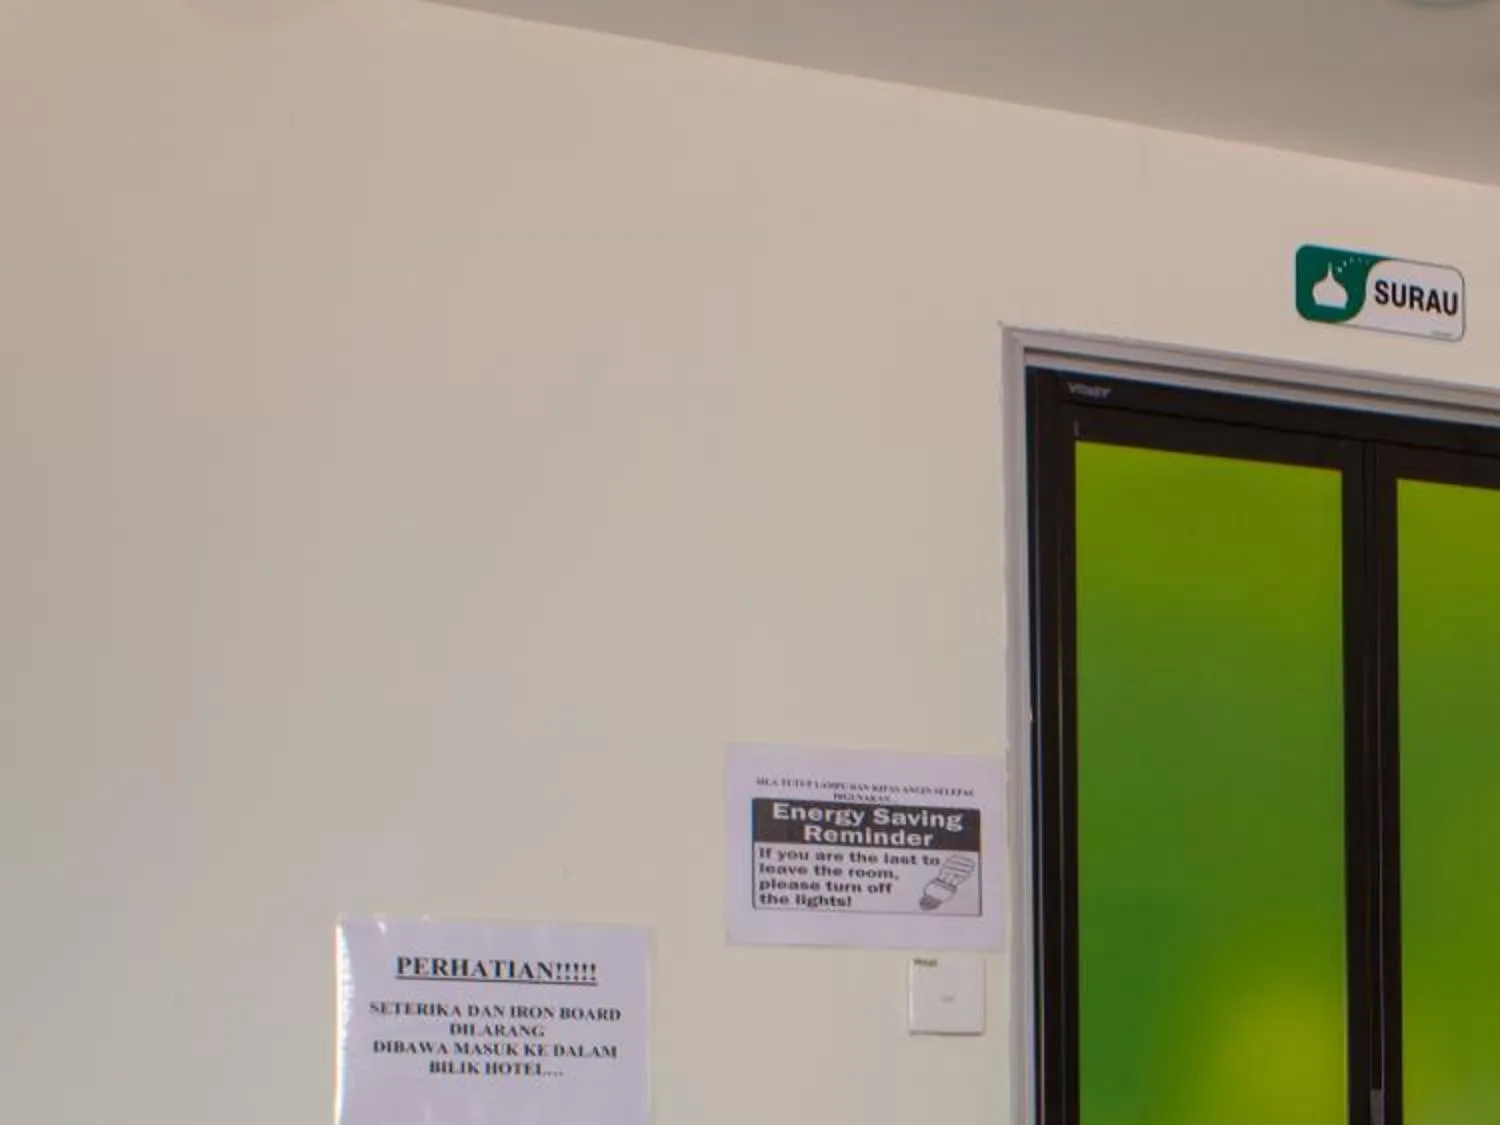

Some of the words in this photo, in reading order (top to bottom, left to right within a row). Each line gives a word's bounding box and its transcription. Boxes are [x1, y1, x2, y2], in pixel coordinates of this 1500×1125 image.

[1374, 279, 1458, 316] SURAU
[772, 802, 865, 827] Energy
[873, 807, 964, 832] Saving
[804, 824, 934, 846] Reminder
[758, 847, 772, 860] If
[777, 849, 809, 863] you
[815, 852, 844, 863] are
[849, 852, 878, 864] the
[883, 853, 917, 866] last
[922, 854, 940, 866] to
[758, 863, 811, 876] leave
[814, 865, 843, 878] the
[848, 868, 899, 881] room,
[758, 878, 821, 893] please
[826, 880, 862, 894] turn
[867, 882, 892, 895] off
[759, 892, 789, 906] the
[795, 894, 852, 910] lights!
[396, 955, 598, 983] PERHATIAN!!!!!
[368, 1001, 462, 1018] SETERIKA
[468, 1004, 504, 1019] DAN
[510, 1006, 554, 1020] IRON
[559, 1006, 622, 1022] BOARD
[450, 1023, 545, 1037] DILARANG
[373, 1039, 448, 1055] DIBAWA
[453, 1041, 518, 1057] MASUK
[523, 1043, 549, 1058] KE
[553, 1044, 618, 1059] DALAM
[429, 1060, 480, 1075] BILIK
